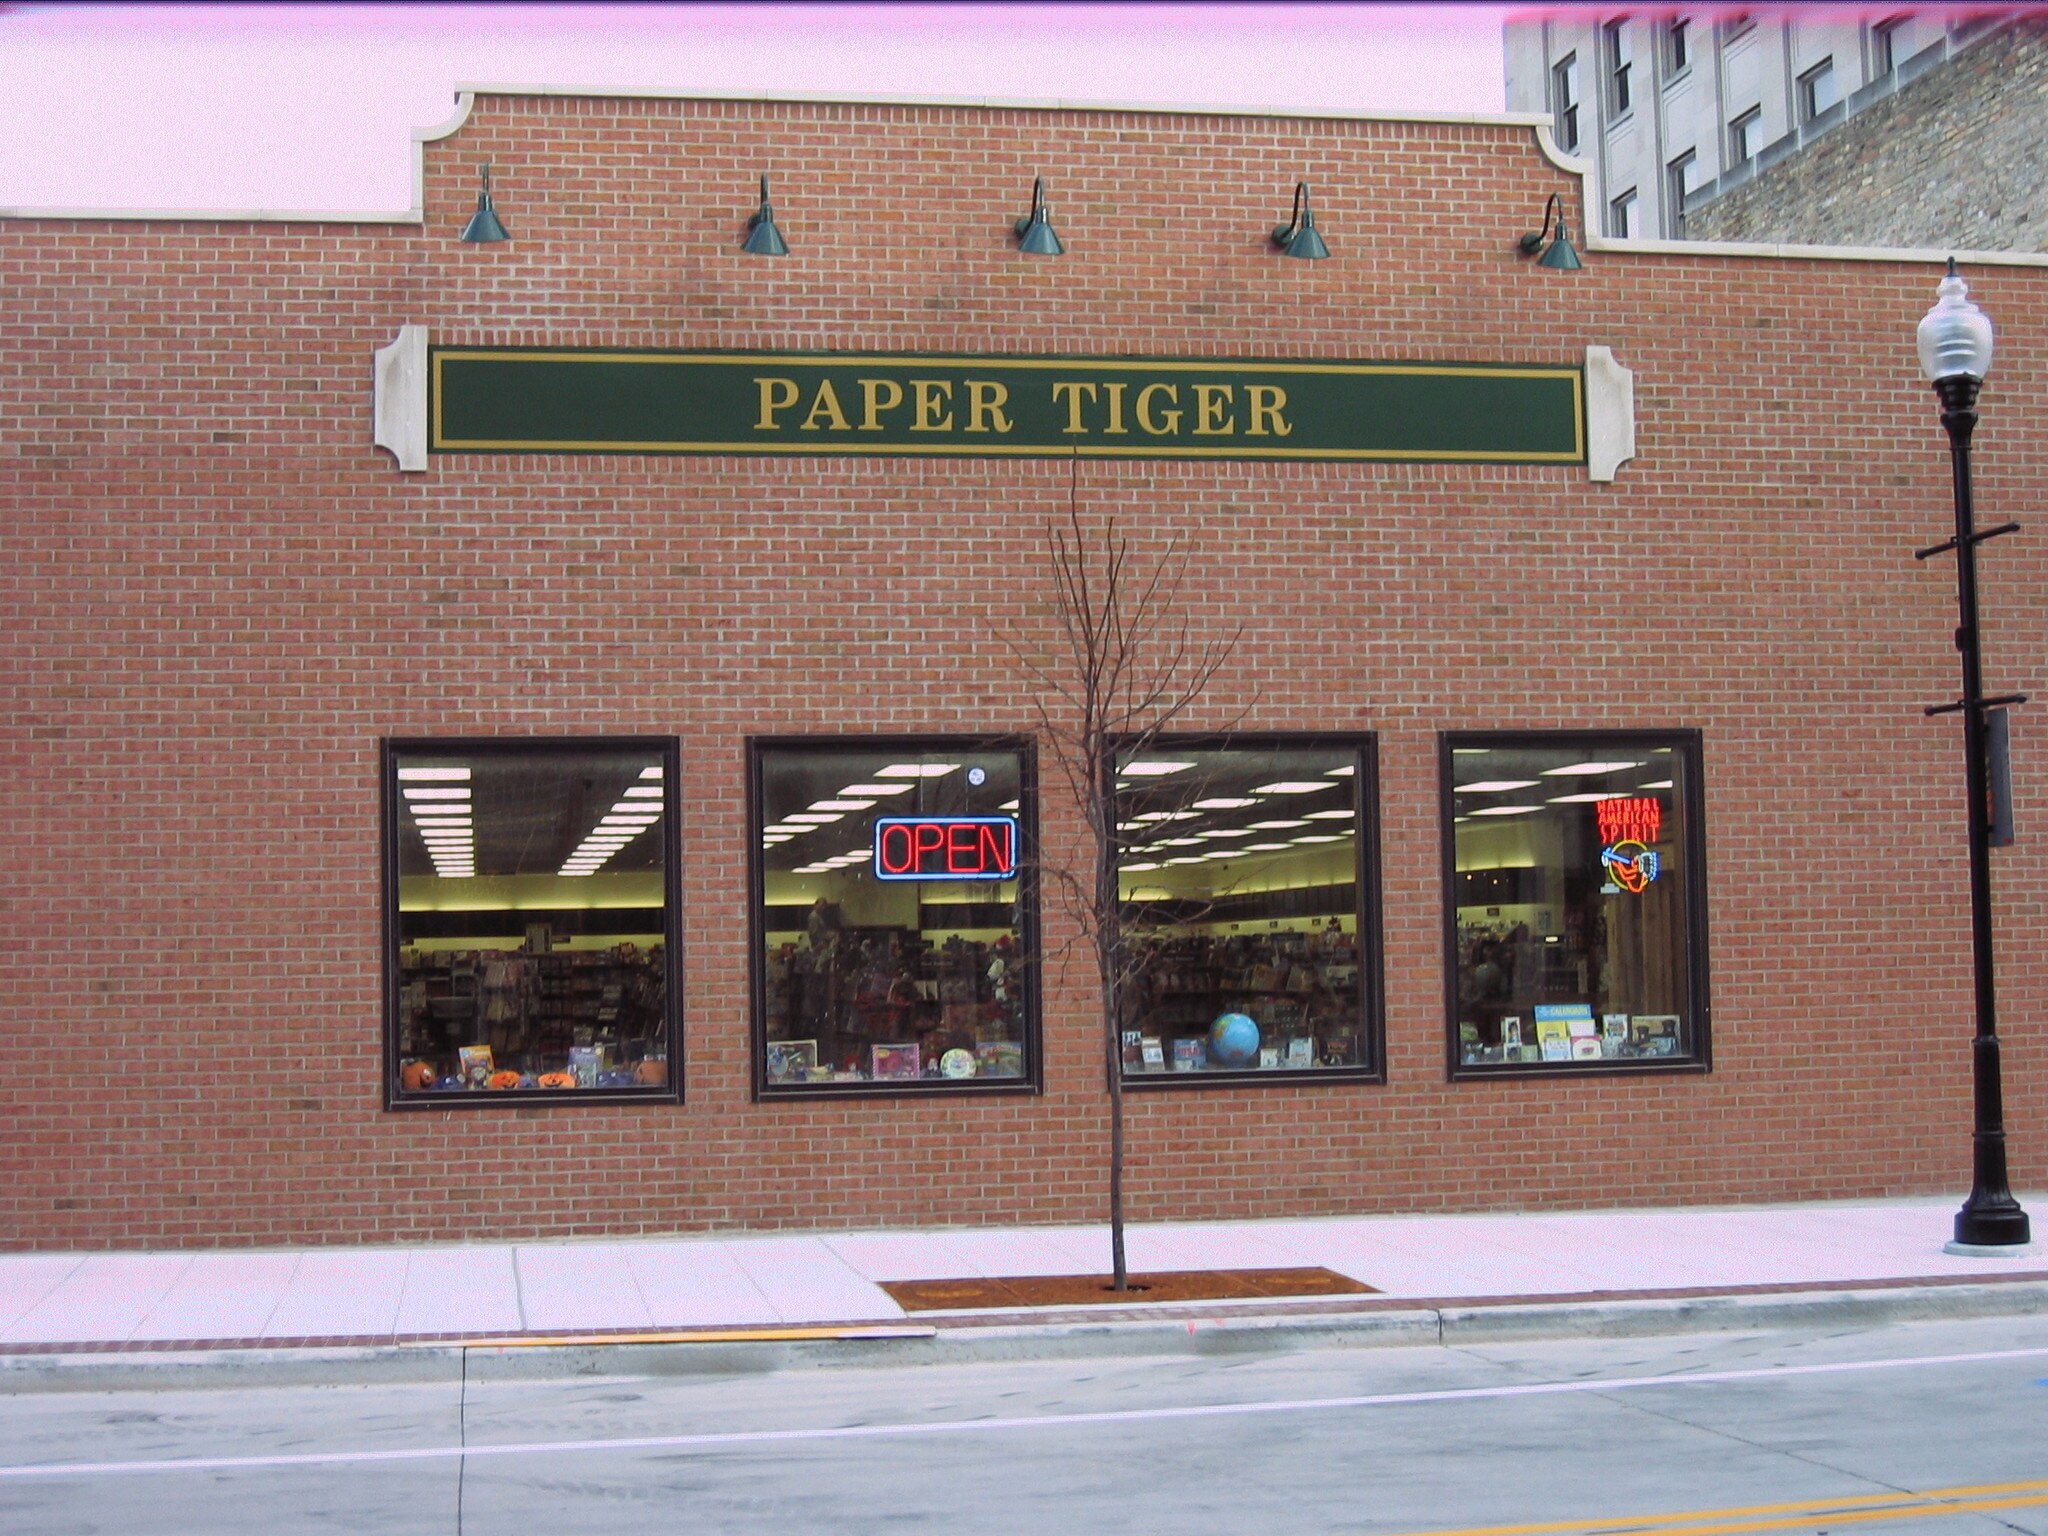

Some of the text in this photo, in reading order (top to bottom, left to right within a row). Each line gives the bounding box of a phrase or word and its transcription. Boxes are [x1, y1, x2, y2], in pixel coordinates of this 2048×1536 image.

[752, 377, 1293, 435] PAPER TIGER
[1597, 798, 1659, 812] NATURAL
[1598, 811, 1660, 825] AMERICAN
[1600, 824, 1660, 844] SPIRIT
[883, 824, 1009, 873] OPEN
